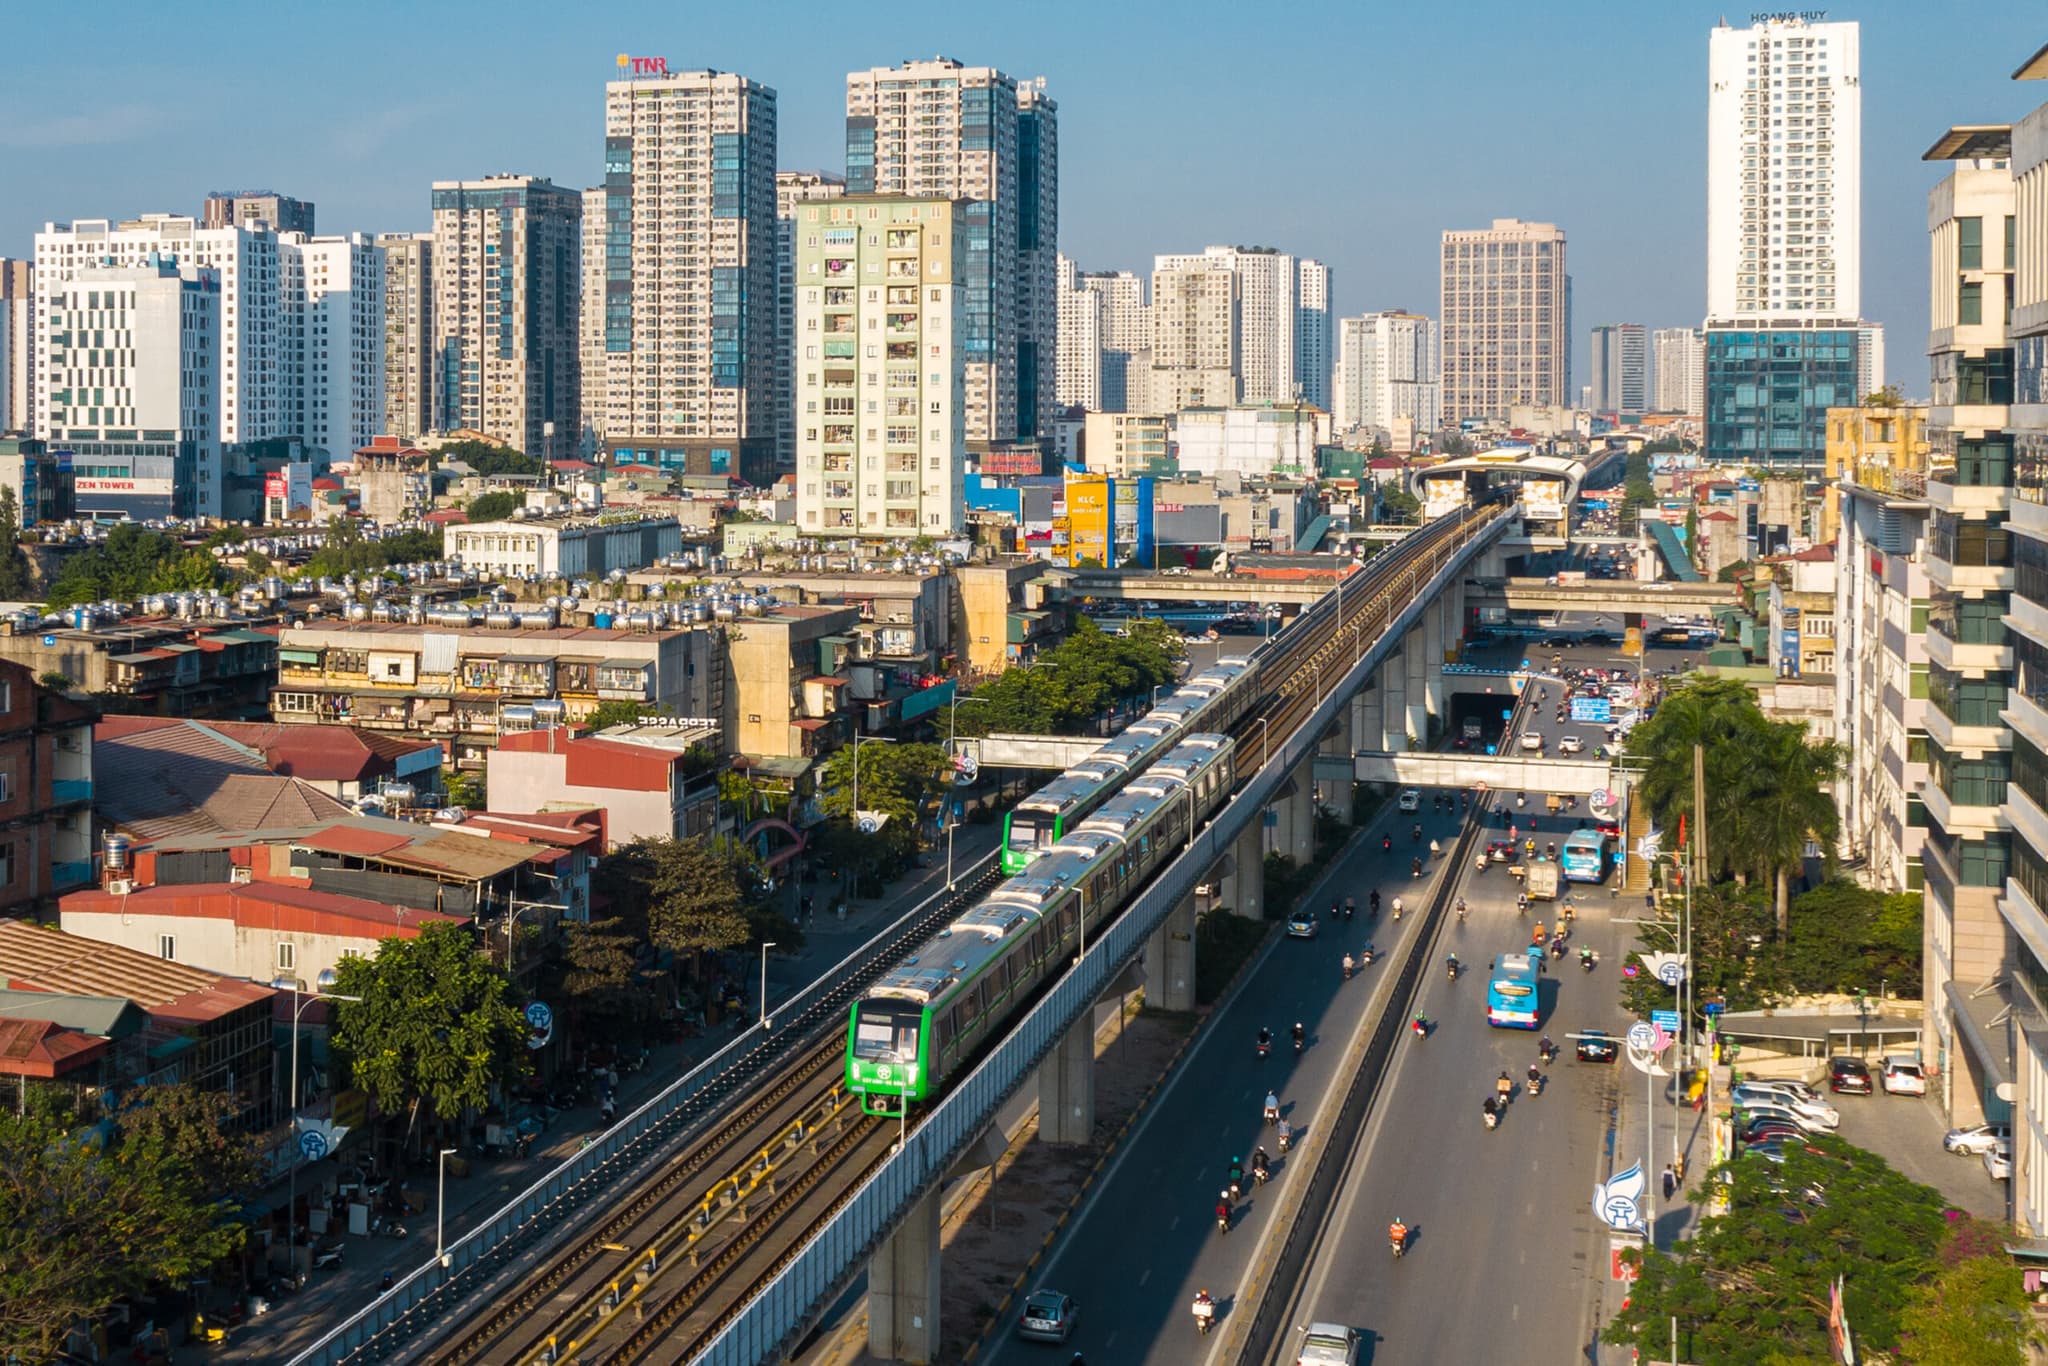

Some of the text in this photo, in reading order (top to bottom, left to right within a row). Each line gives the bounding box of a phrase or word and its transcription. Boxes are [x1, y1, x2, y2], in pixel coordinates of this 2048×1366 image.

[1751, 10, 1826, 22] HOANG HUY
[632, 56, 667, 74] TNR
[77, 481, 135, 489] ZEN TOWER
[1078, 496, 1096, 504] KLC
